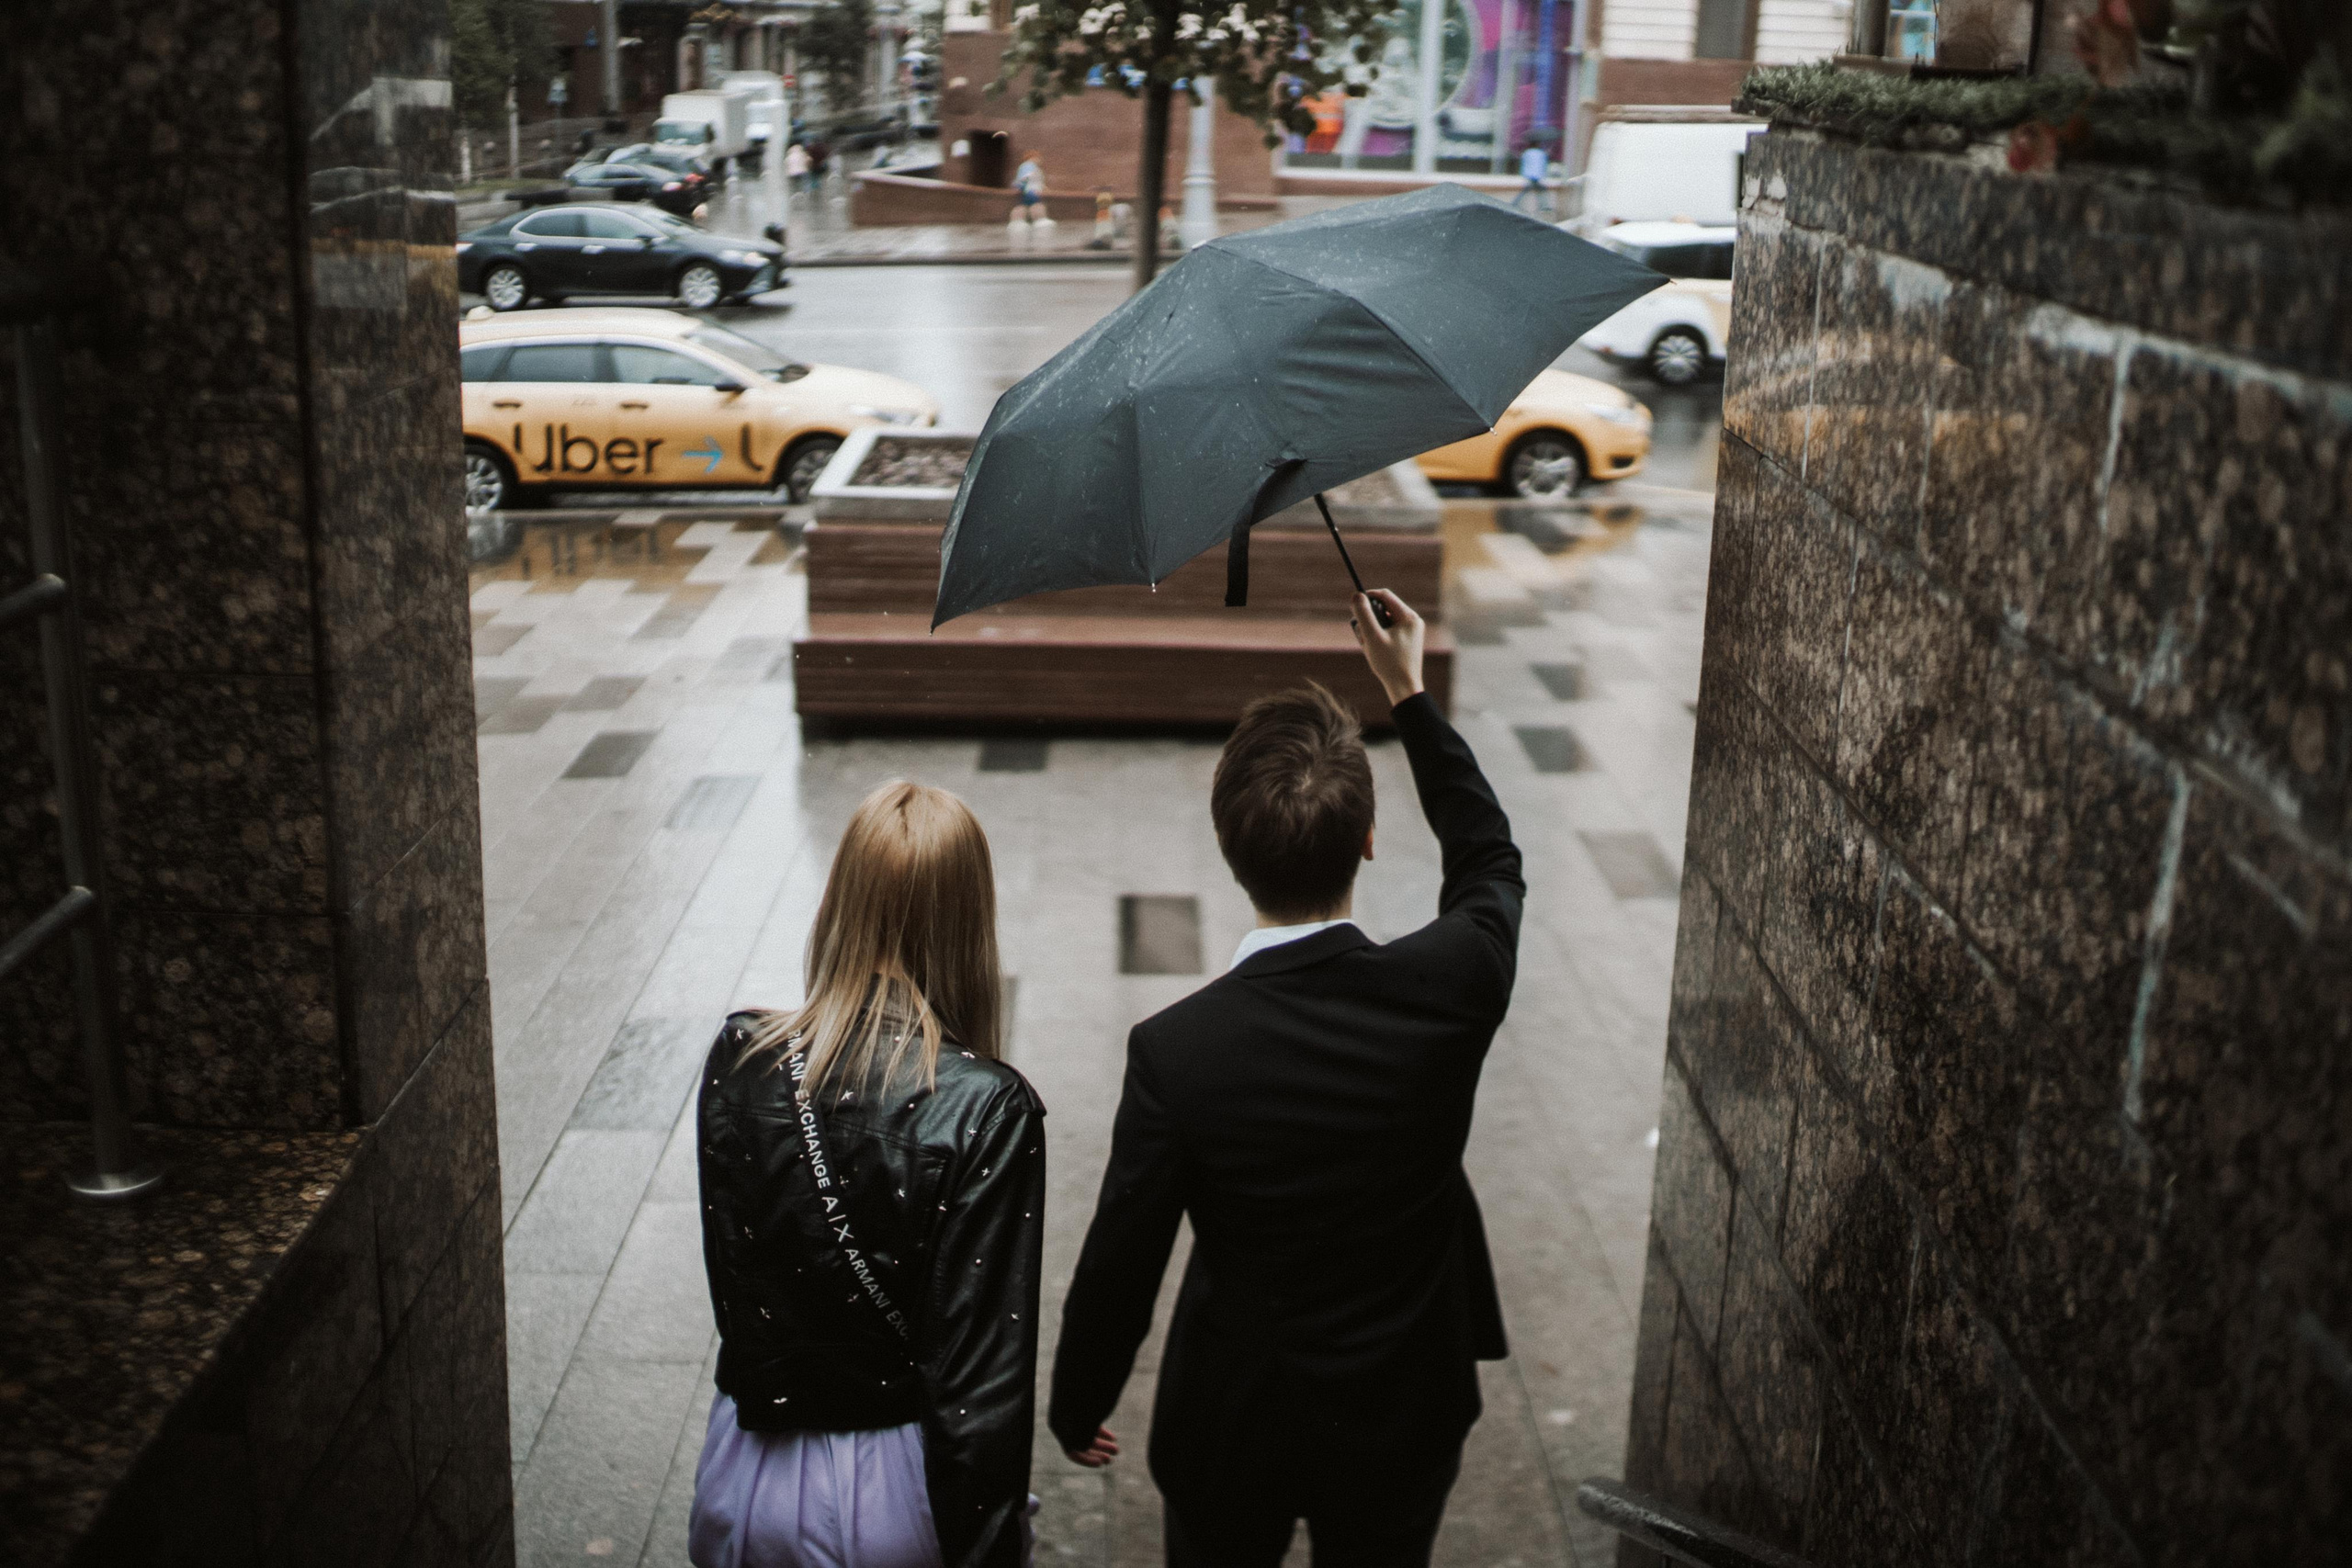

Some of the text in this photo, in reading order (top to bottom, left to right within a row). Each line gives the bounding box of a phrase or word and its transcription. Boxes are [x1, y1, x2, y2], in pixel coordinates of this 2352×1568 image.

[514, 422, 665, 475] Uber
[794, 1089, 831, 1190] EXCHANGE
[844, 1247, 892, 1309] ARMANI
